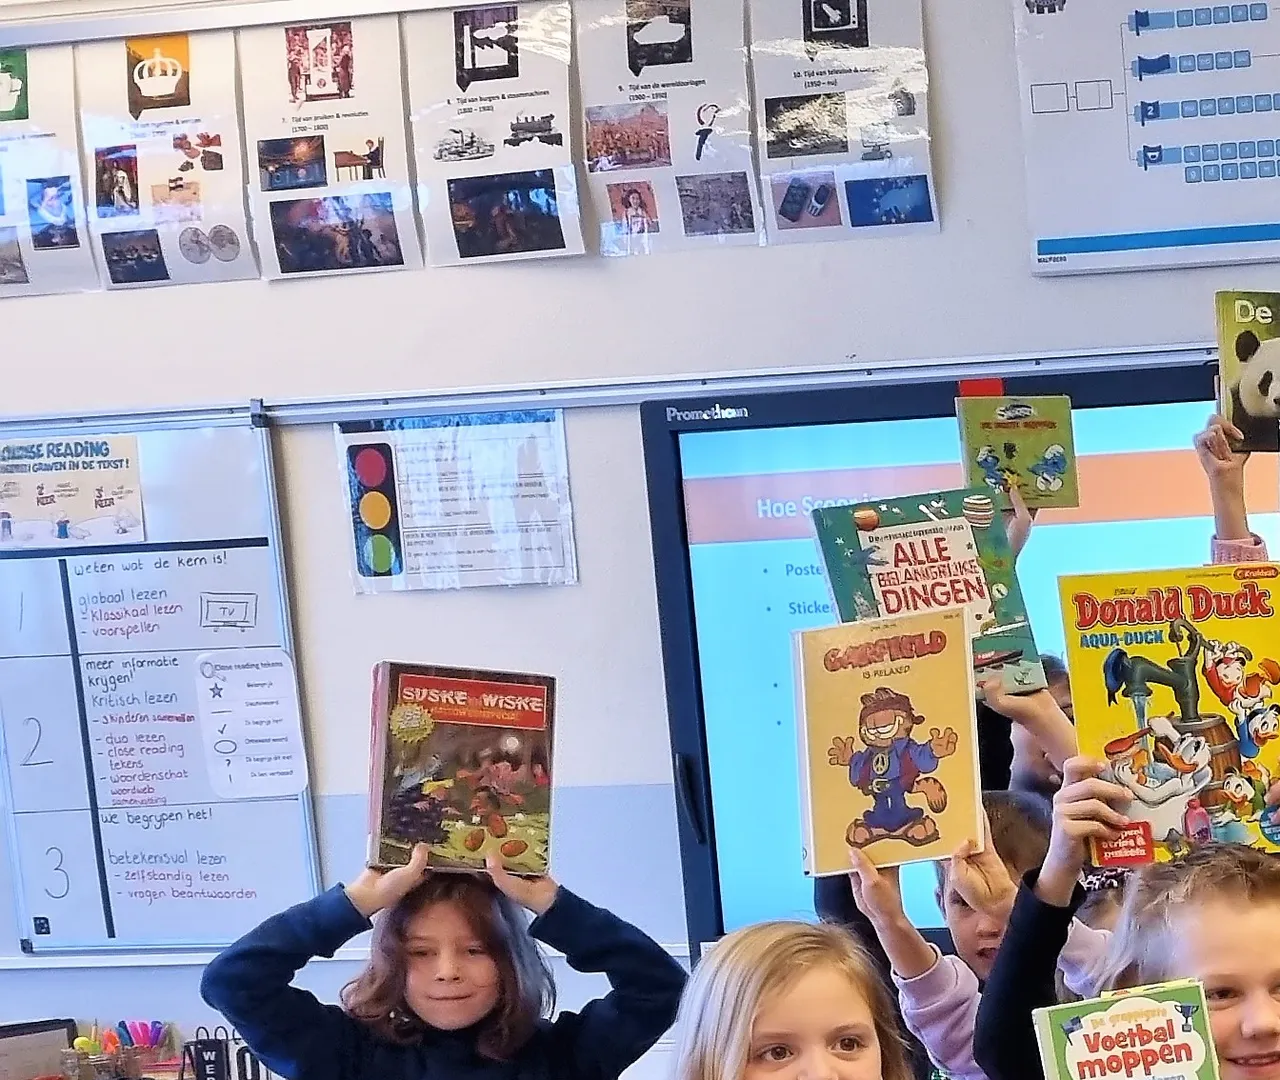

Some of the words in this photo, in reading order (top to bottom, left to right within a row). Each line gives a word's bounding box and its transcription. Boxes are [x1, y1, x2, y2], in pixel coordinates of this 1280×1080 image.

[1234, 299, 1272, 326] De
[665, 403, 749, 422] Promethean
[757, 497, 797, 518] Hoe
[893, 536, 952, 568] ALLE
[74, 562, 115, 576] weten
[121, 558, 144, 571] wat
[154, 557, 170, 569] de
[177, 555, 208, 567] kern
[785, 563, 822, 577] Poste
[878, 558, 979, 588] BELANGRIJKE
[79, 590, 125, 615] globaal
[131, 588, 168, 601] lezen
[881, 576, 985, 614] DINGEN
[154, 604, 184, 616] lezen
[219, 606, 236, 617] TV
[789, 601, 832, 616] Sticke
[1073, 585, 1182, 630] Donald
[1186, 581, 1273, 623] Duck
[93, 622, 160, 640] voorspellen
[1080, 629, 1164, 649] AQUA-DUCK
[823, 630, 947, 672] GARFIELD
[86, 659, 115, 671] meer
[122, 657, 180, 672] informatie
[873, 665, 911, 679] RELAXED
[145, 691, 178, 705] lezen
[402, 686, 469, 705] SUSKE
[481, 693, 544, 712] WISKE
[20, 717, 54, 767] 2
[135, 733, 166, 744] lezen
[108, 745, 136, 758] close
[140, 743, 185, 758] reading
[110, 769, 189, 784] woordenschat
[108, 848, 188, 866] betekenisvol
[197, 850, 227, 866] lezen
[44, 846, 71, 900] 3
[124, 869, 192, 887] zelfstandig
[199, 870, 230, 882] lezen
[129, 889, 167, 905] vragen
[171, 887, 257, 899] beantwoorden
[1083, 1019, 1176, 1053] Voetbal
[1076, 1043, 1193, 1080] moppen
